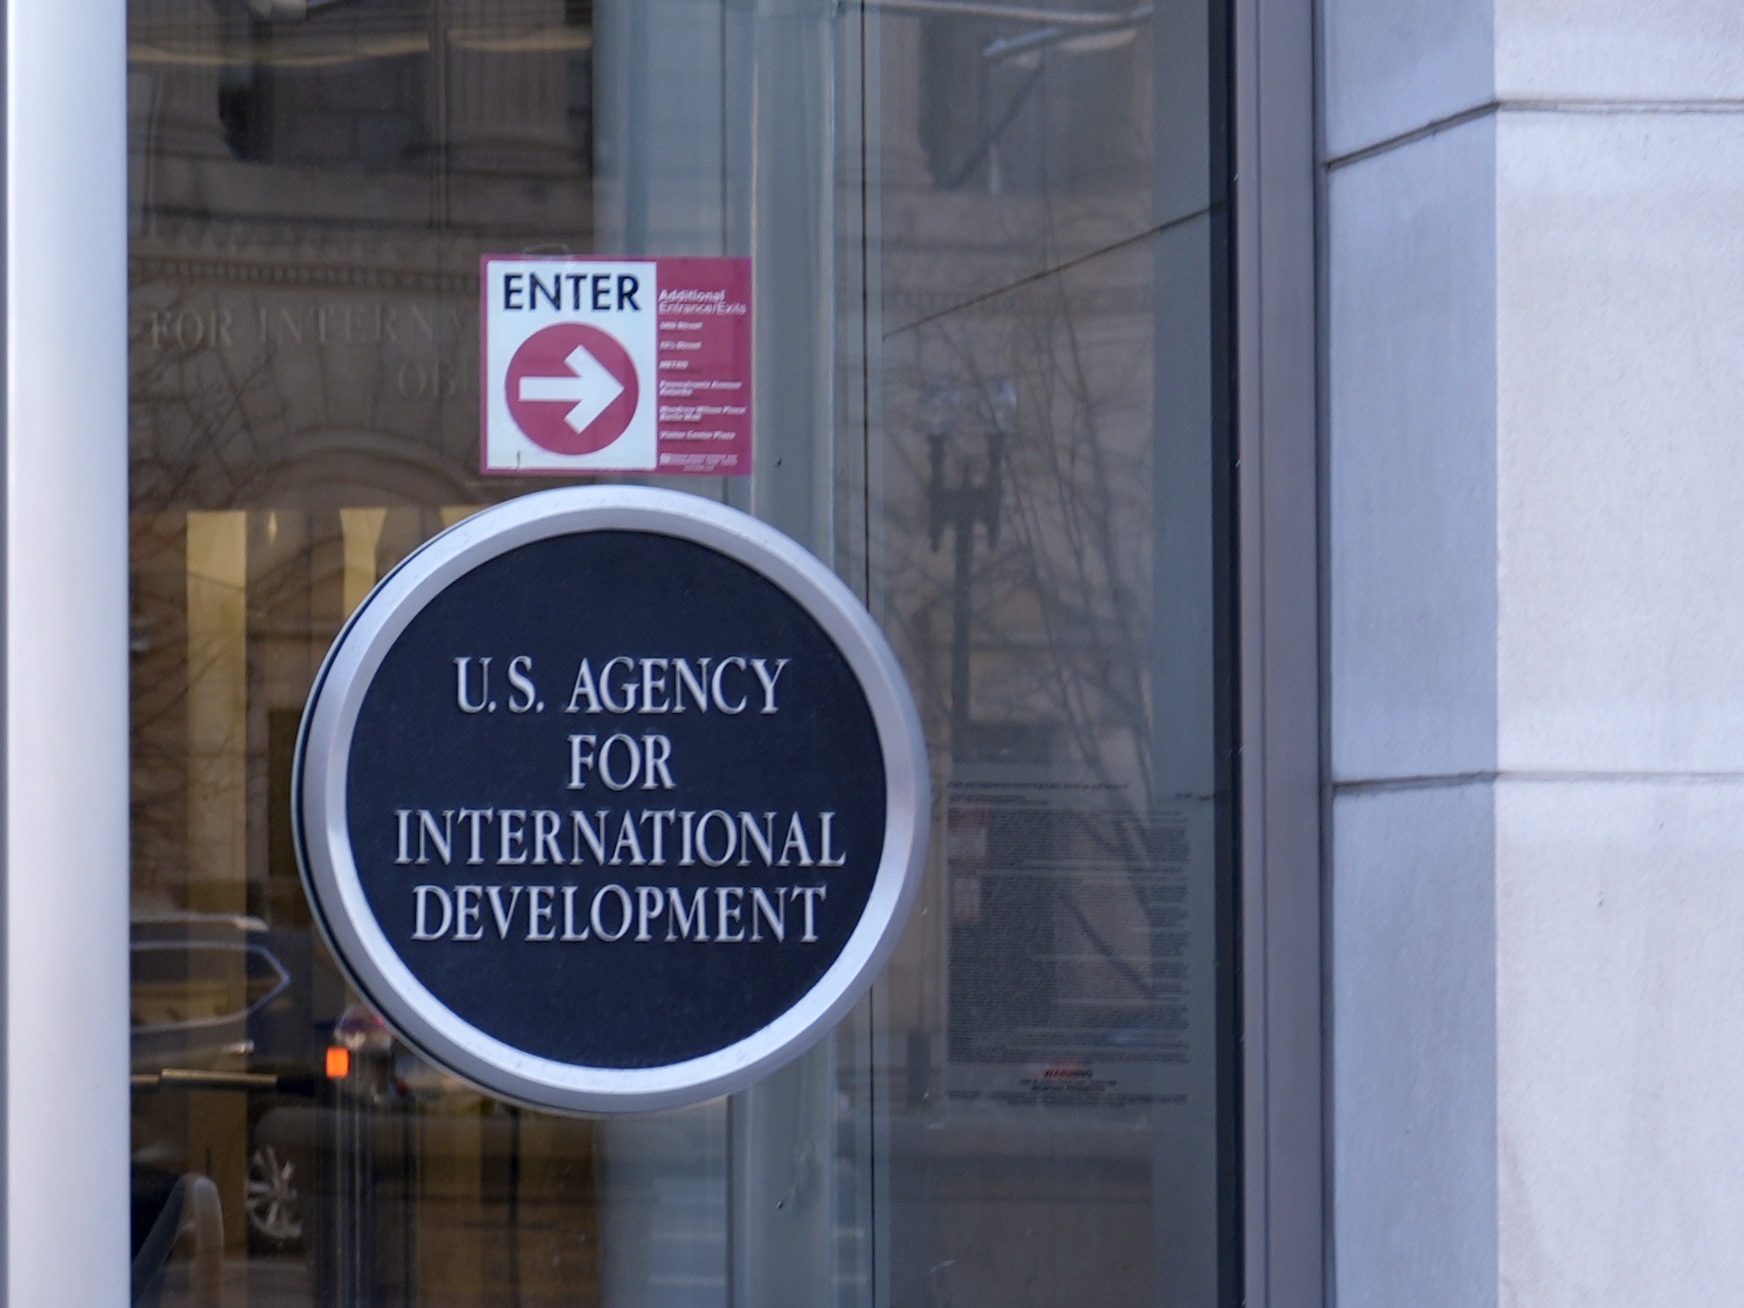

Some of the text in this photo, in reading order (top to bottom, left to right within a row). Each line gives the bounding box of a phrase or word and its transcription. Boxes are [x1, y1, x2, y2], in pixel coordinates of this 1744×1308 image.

[503, 272, 641, 312] ENTER
[150, 308, 233, 349] FOR
[454, 655, 790, 715] U.S. AGENCY
[566, 732, 676, 791] FOR
[393, 807, 846, 867] INTERNATIONAL
[411, 883, 826, 943] DEVELOPMENT
